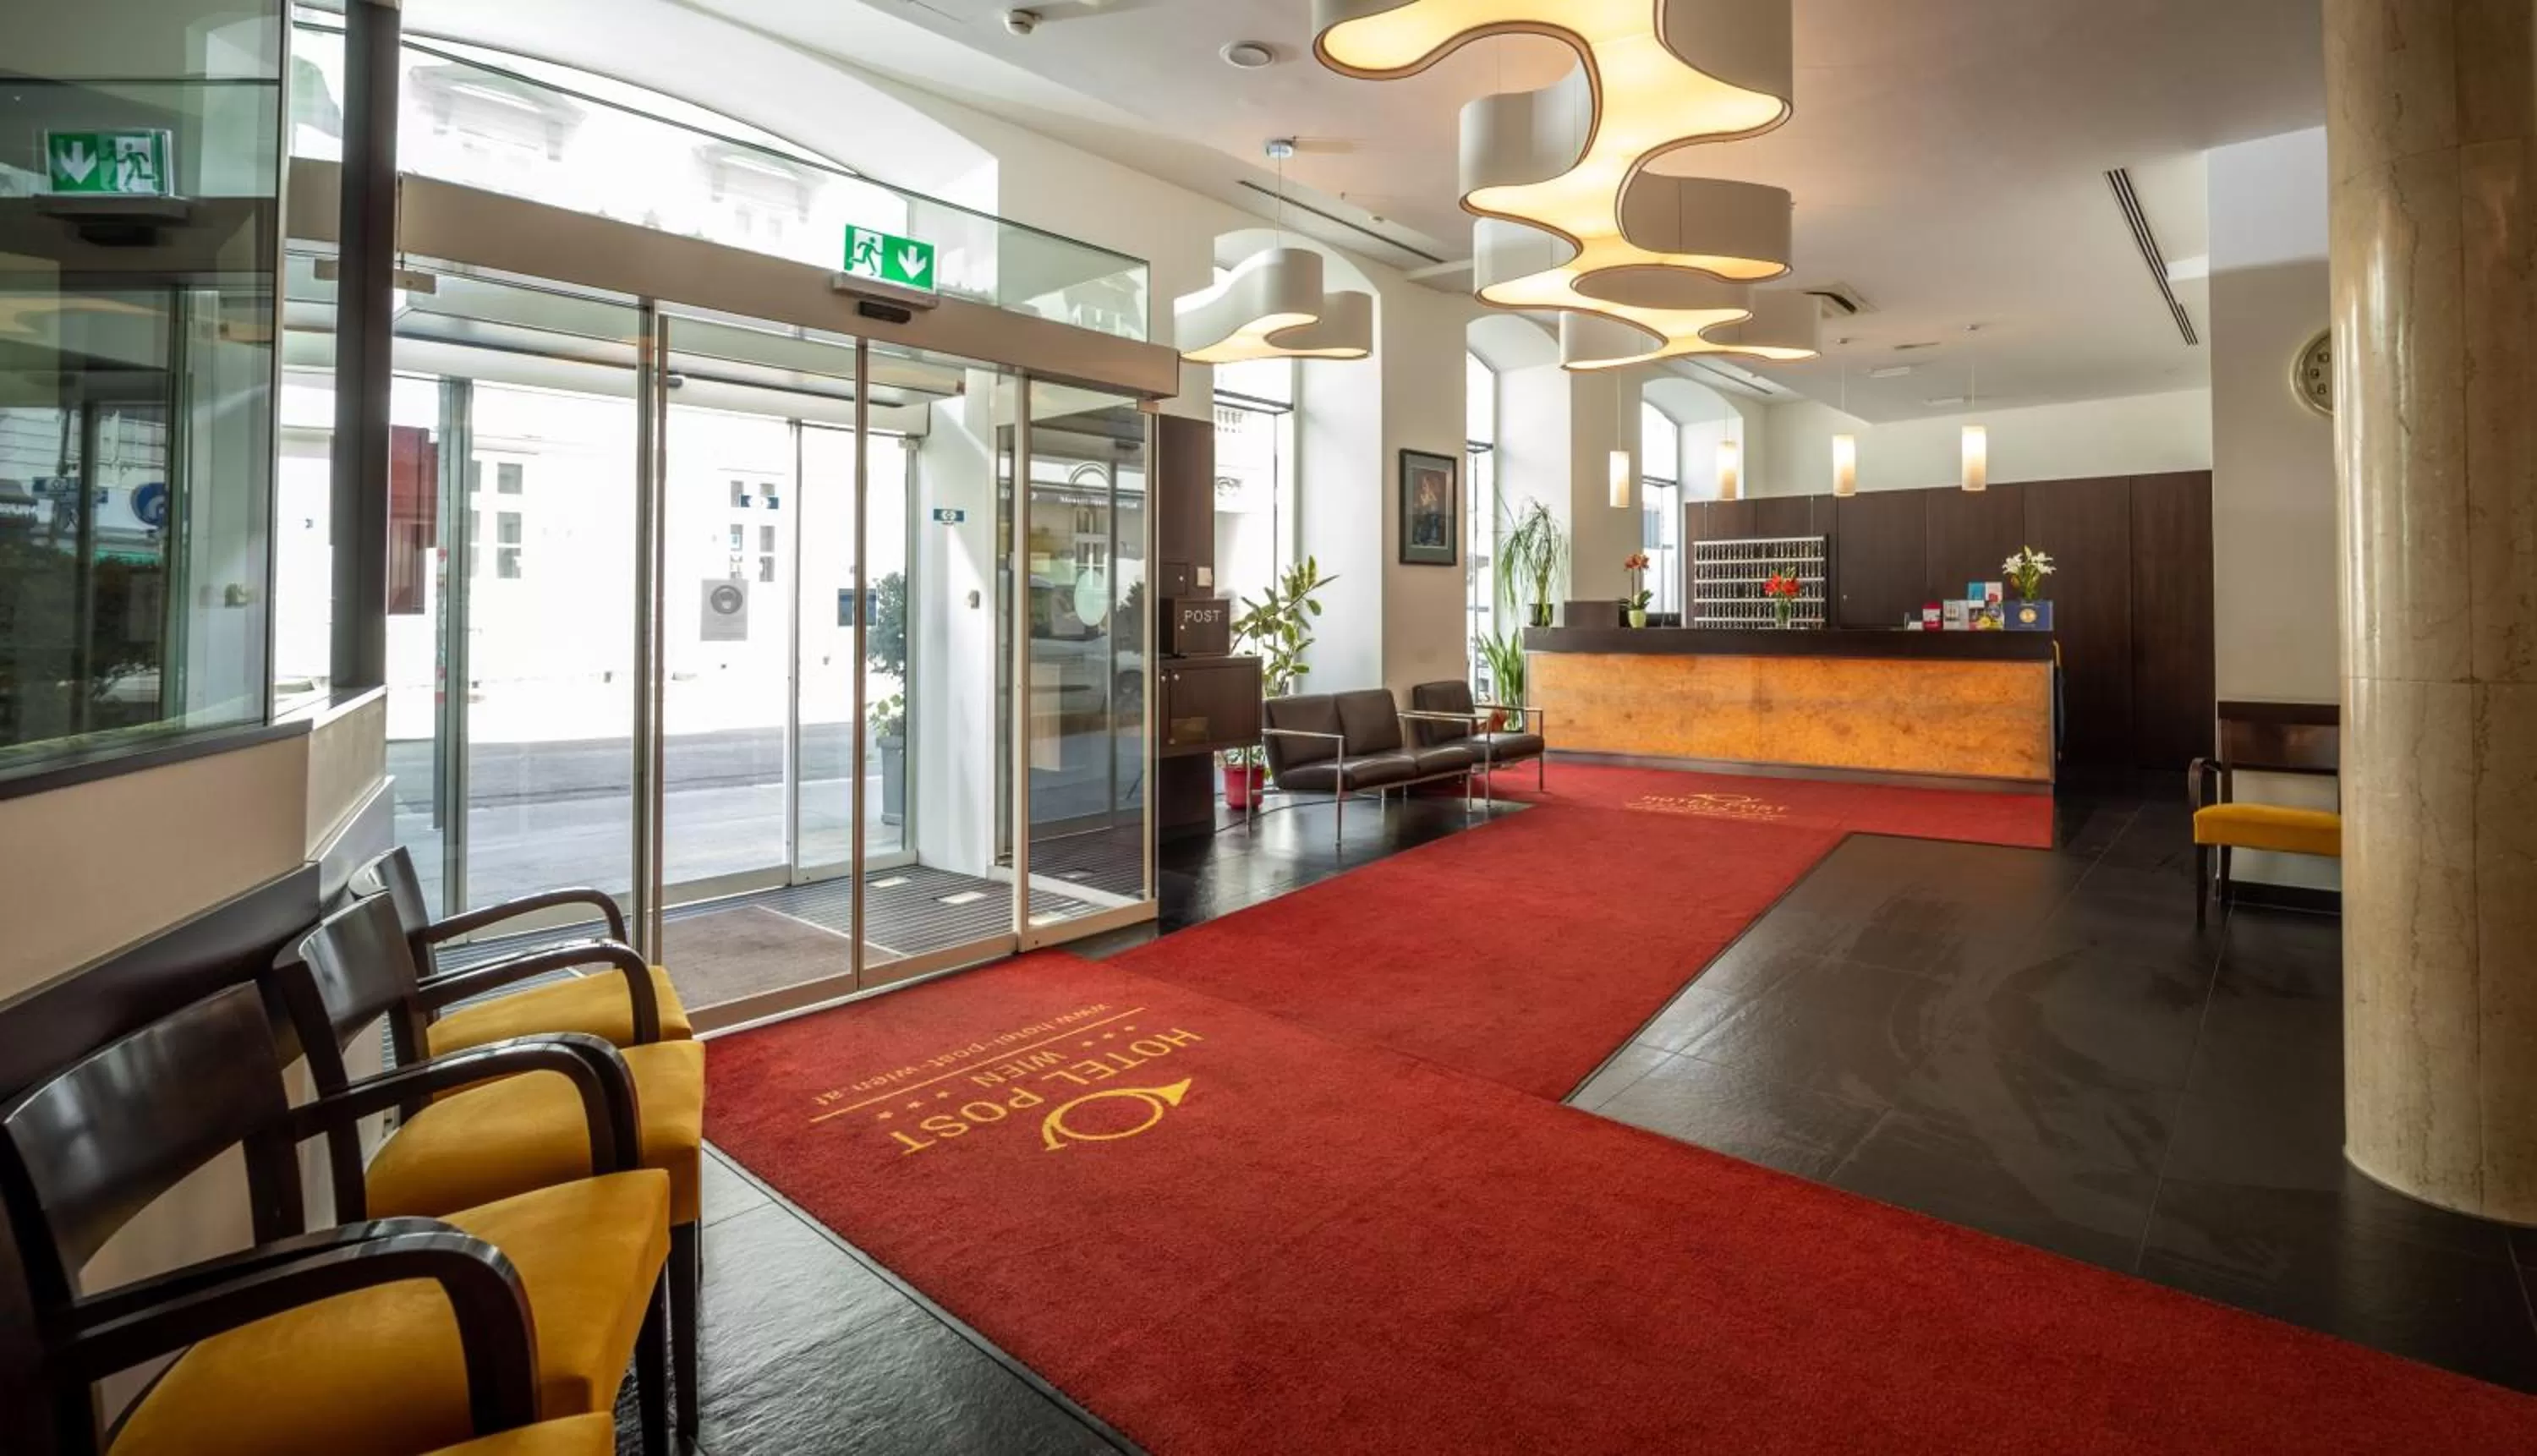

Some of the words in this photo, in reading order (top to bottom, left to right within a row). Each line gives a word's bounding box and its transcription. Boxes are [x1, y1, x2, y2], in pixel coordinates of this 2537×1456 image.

[1184, 609, 1223, 623] POST
[970, 1050, 1068, 1087] WIEN
[1041, 1027, 1203, 1086] HOTEL
[890, 1087, 1044, 1156] POST
